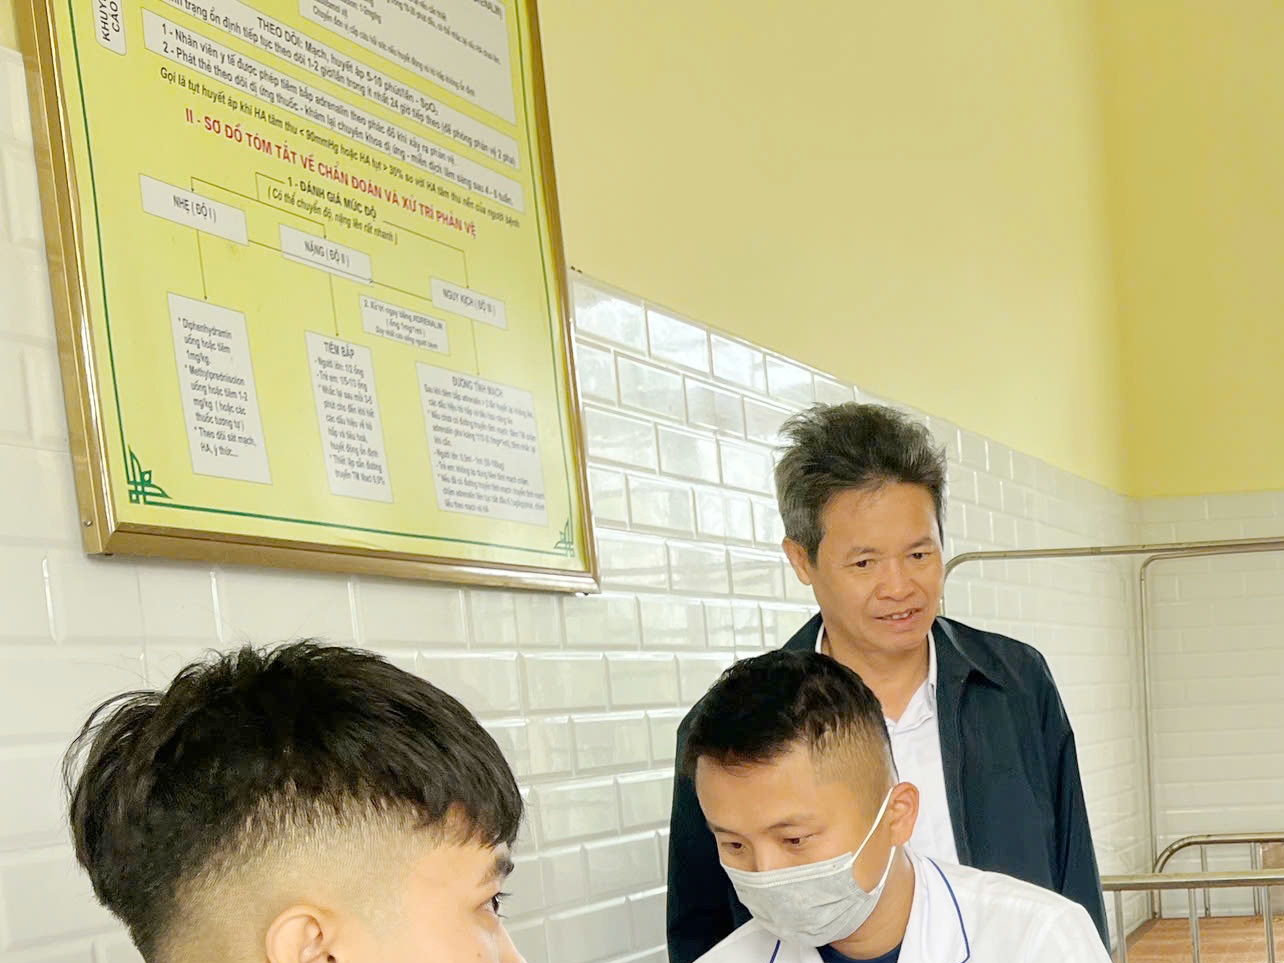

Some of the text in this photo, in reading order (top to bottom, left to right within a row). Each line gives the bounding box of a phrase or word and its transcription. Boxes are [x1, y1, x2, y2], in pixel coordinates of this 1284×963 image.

[99, 0, 111, 42] KHUY
[109, 1, 120, 32] CÁO
[185, 0, 207, 21] trạng
[223, 18, 241, 35] định
[274, 42, 291, 59] theo
[307, 57, 318, 72] 1-2
[257, 16, 282, 39] THEO
[162, 23, 166, 35] 1
[175, 28, 198, 50] Nhân
[200, 42, 217, 58] viên
[220, 52, 225, 64] y
[227, 53, 235, 66] tế
[237, 57, 257, 76] được
[163, 40, 168, 53] 2
[176, 46, 196, 67] Phát
[198, 57, 211, 73] thẻ
[213, 64, 232, 83] theo
[234, 75, 247, 89] dõi
[160, 66, 175, 84] Gọi
[178, 73, 185, 87] là
[188, 78, 200, 94] tụt
[202, 84, 225, 104] huyết
[254, 106, 266, 121] HA
[185, 106, 193, 123] II
[204, 114, 220, 134] SƠ
[225, 123, 242, 143] ĐỒ
[245, 132, 272, 155] TÓM
[274, 141, 296, 165] TẮT
[300, 153, 314, 172] VỀ
[174, 195, 189, 212] NHẸ
[196, 203, 207, 219] ĐỘ
[288, 176, 292, 187] 1
[300, 180, 325, 199] ĐÁNH
[327, 190, 342, 205] GIÁ
[344, 196, 362, 214] MỨC
